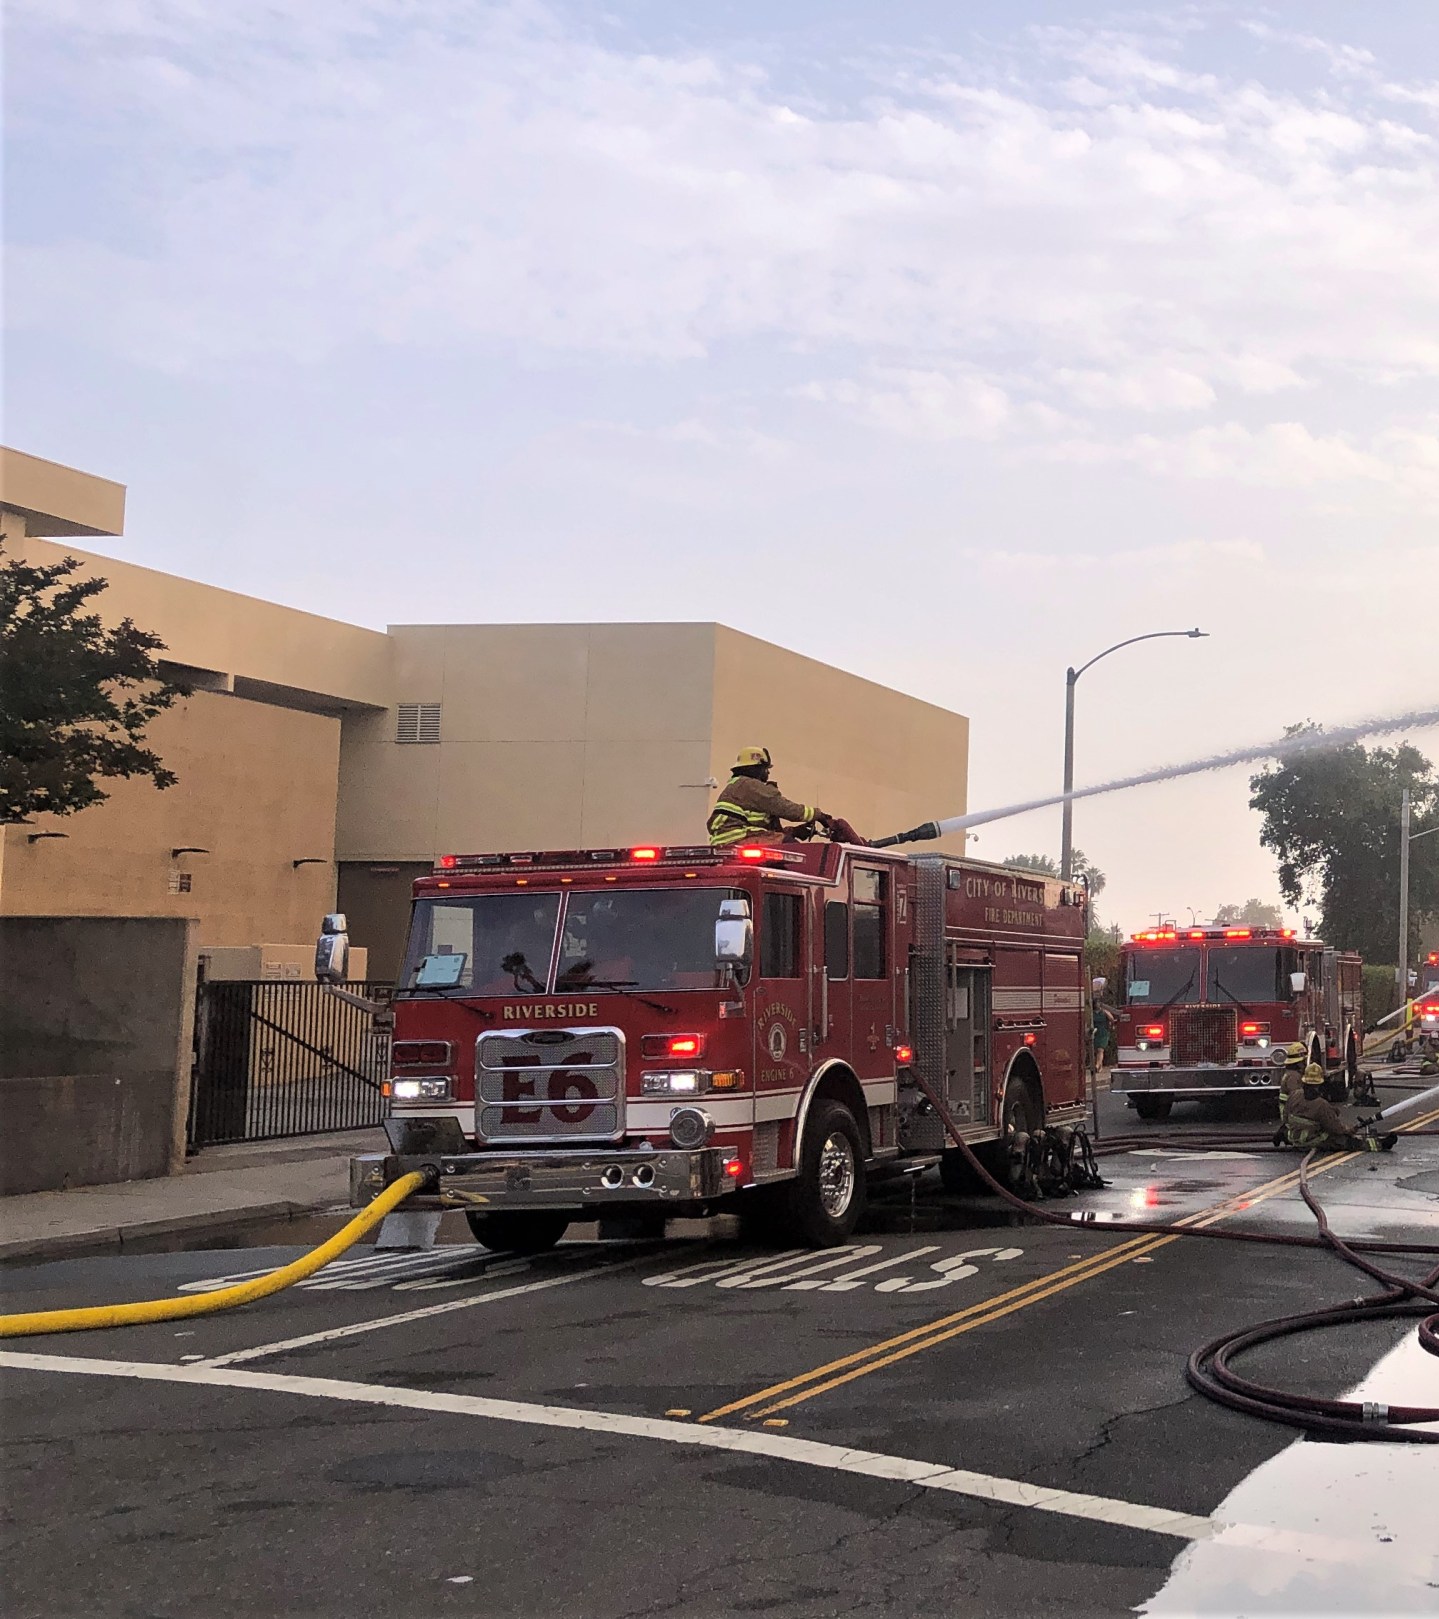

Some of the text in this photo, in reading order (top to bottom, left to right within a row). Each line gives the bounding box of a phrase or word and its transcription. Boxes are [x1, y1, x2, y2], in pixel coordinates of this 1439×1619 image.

[966, 877, 989, 898] CITY
[994, 880, 1007, 898] OF
[984, 907, 1043, 927] FIRE DEPARTMENT
[503, 1003, 598, 1020] RIVERSIDE
[757, 1001, 797, 1030] RIVERSIDE
[760, 1068, 794, 1082] ENGINE 6
[501, 1051, 599, 1125] E6
